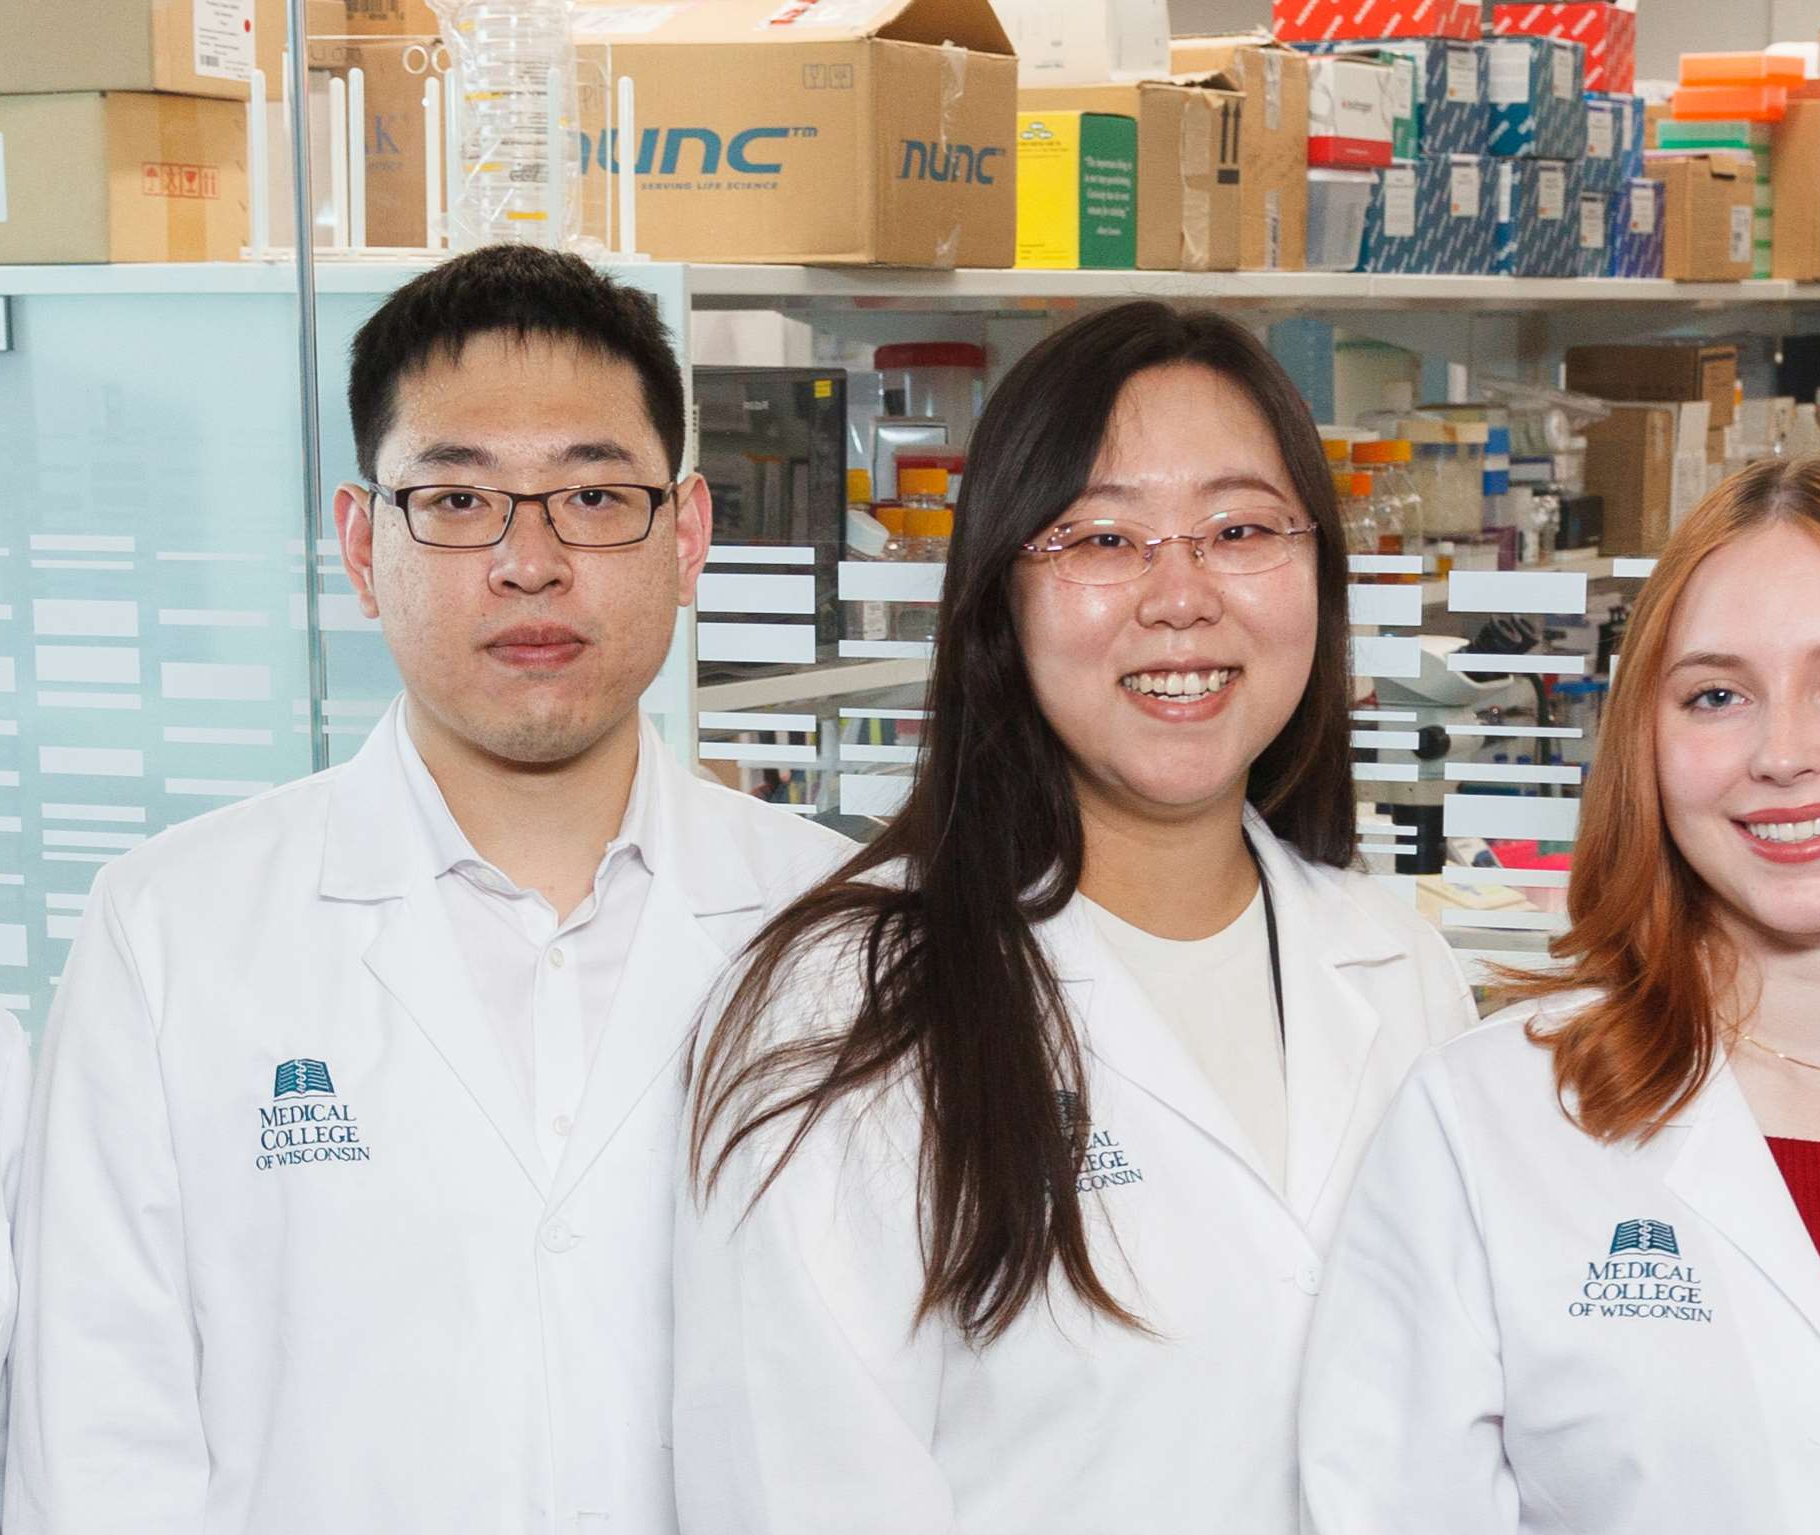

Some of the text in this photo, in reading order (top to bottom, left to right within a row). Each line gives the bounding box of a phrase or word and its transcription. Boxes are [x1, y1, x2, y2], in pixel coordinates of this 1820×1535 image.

[897, 139, 1006, 184] nunc
[641, 181, 778, 191] SERVING LIFE SCIENCE
[258, 1103, 357, 1128] MEDICAL
[261, 1125, 360, 1151] COLLEGE
[256, 1146, 371, 1171] OF WISCONSIN
[1587, 1261, 1701, 1284] MEDICAL
[1583, 1281, 1702, 1304] COLLEGE
[1569, 1302, 1713, 1323] OF WISCONSIN
